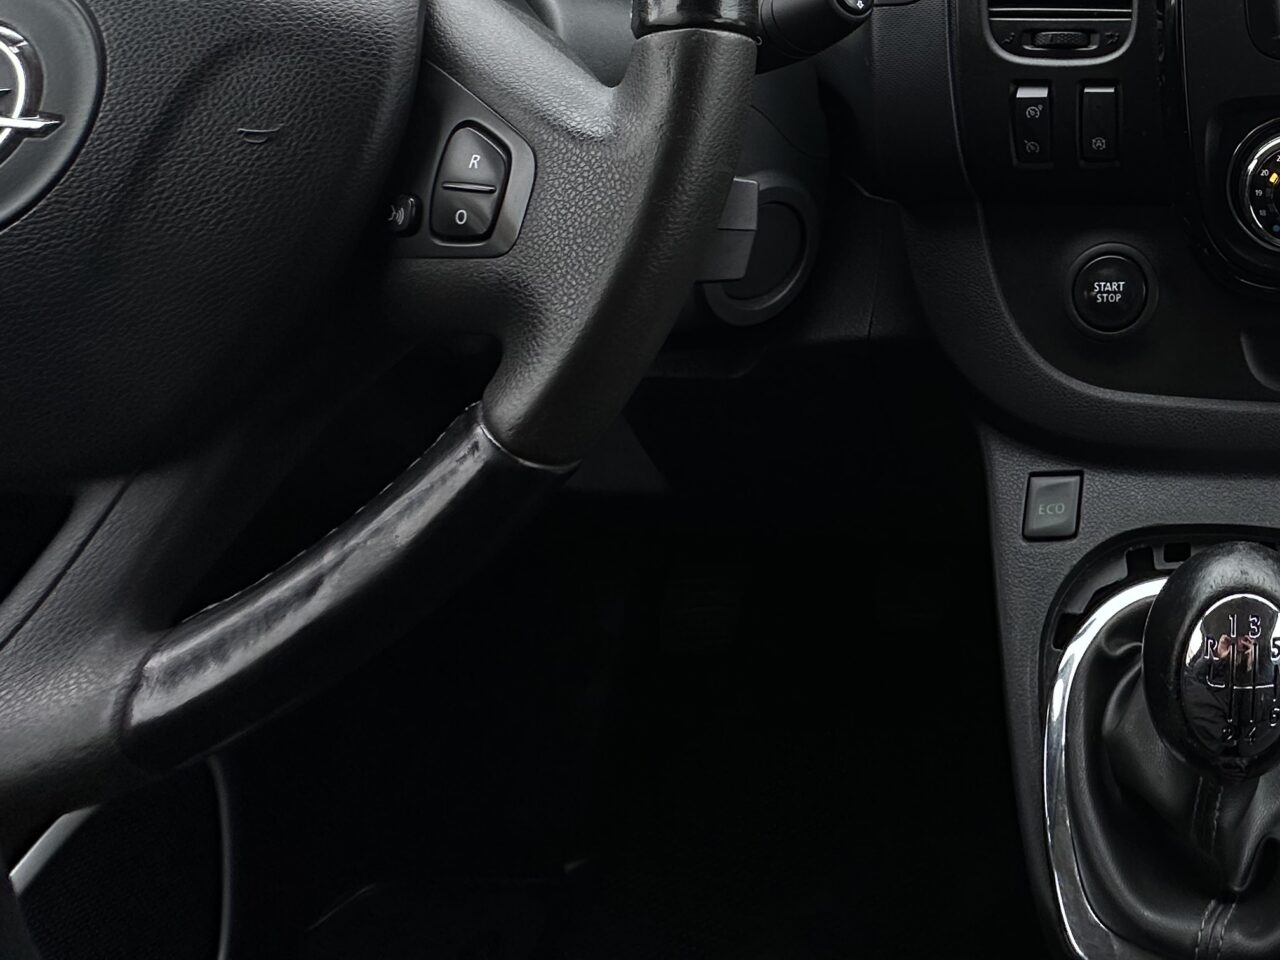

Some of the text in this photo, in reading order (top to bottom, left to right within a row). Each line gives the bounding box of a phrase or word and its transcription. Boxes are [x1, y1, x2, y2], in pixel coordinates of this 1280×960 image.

[468, 154, 481, 169] R
[1260, 169, 1270, 177] 20
[1255, 189, 1263, 197] 19
[1093, 281, 1125, 292] START
[1096, 292, 1122, 303] STOP
[1038, 503, 1065, 515] ECO
[1228, 614, 1237, 638] 1
[1248, 614, 1261, 639] 3
[1204, 635, 1219, 660] R
